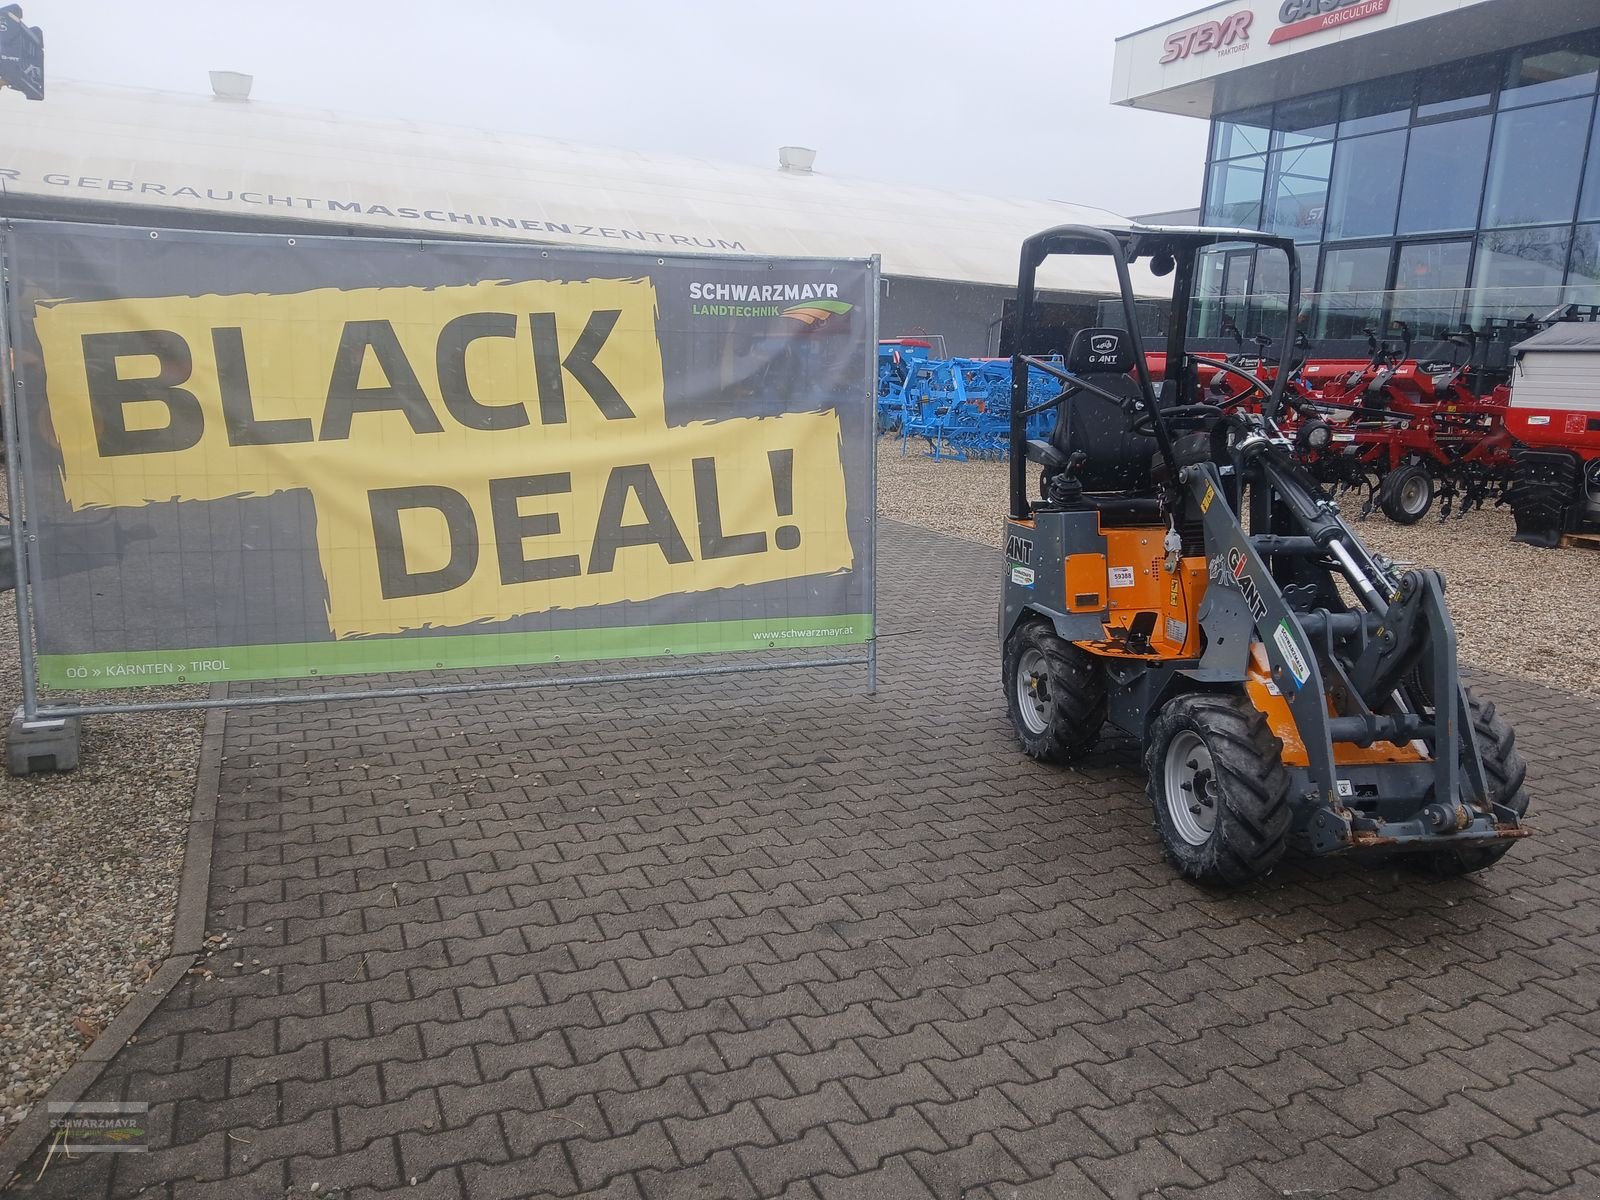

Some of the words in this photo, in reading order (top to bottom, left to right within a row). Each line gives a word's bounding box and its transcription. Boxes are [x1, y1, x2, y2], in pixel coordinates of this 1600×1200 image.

[1321, 1, 1383, 27] AGRICULTURE
[1159, 10, 1254, 65] STEYR
[1217, 42, 1250, 58] TRAKTOREN
[43, 173, 747, 251] GEBRAUCHTMASCHINENZENTRUM
[689, 282, 839, 301] SCHWARZMAYR
[691, 303, 780, 317] LANDTECHNIK
[81, 309, 637, 458] BLACK
[367, 448, 803, 600] DEAL!
[1227, 546, 1268, 623] GIANT
[752, 626, 853, 640] www.schwarzmayr.at
[66, 665, 88, 678] OÖ
[106, 663, 173, 676] KÄRNTEN
[190, 660, 230, 672] TIROL
